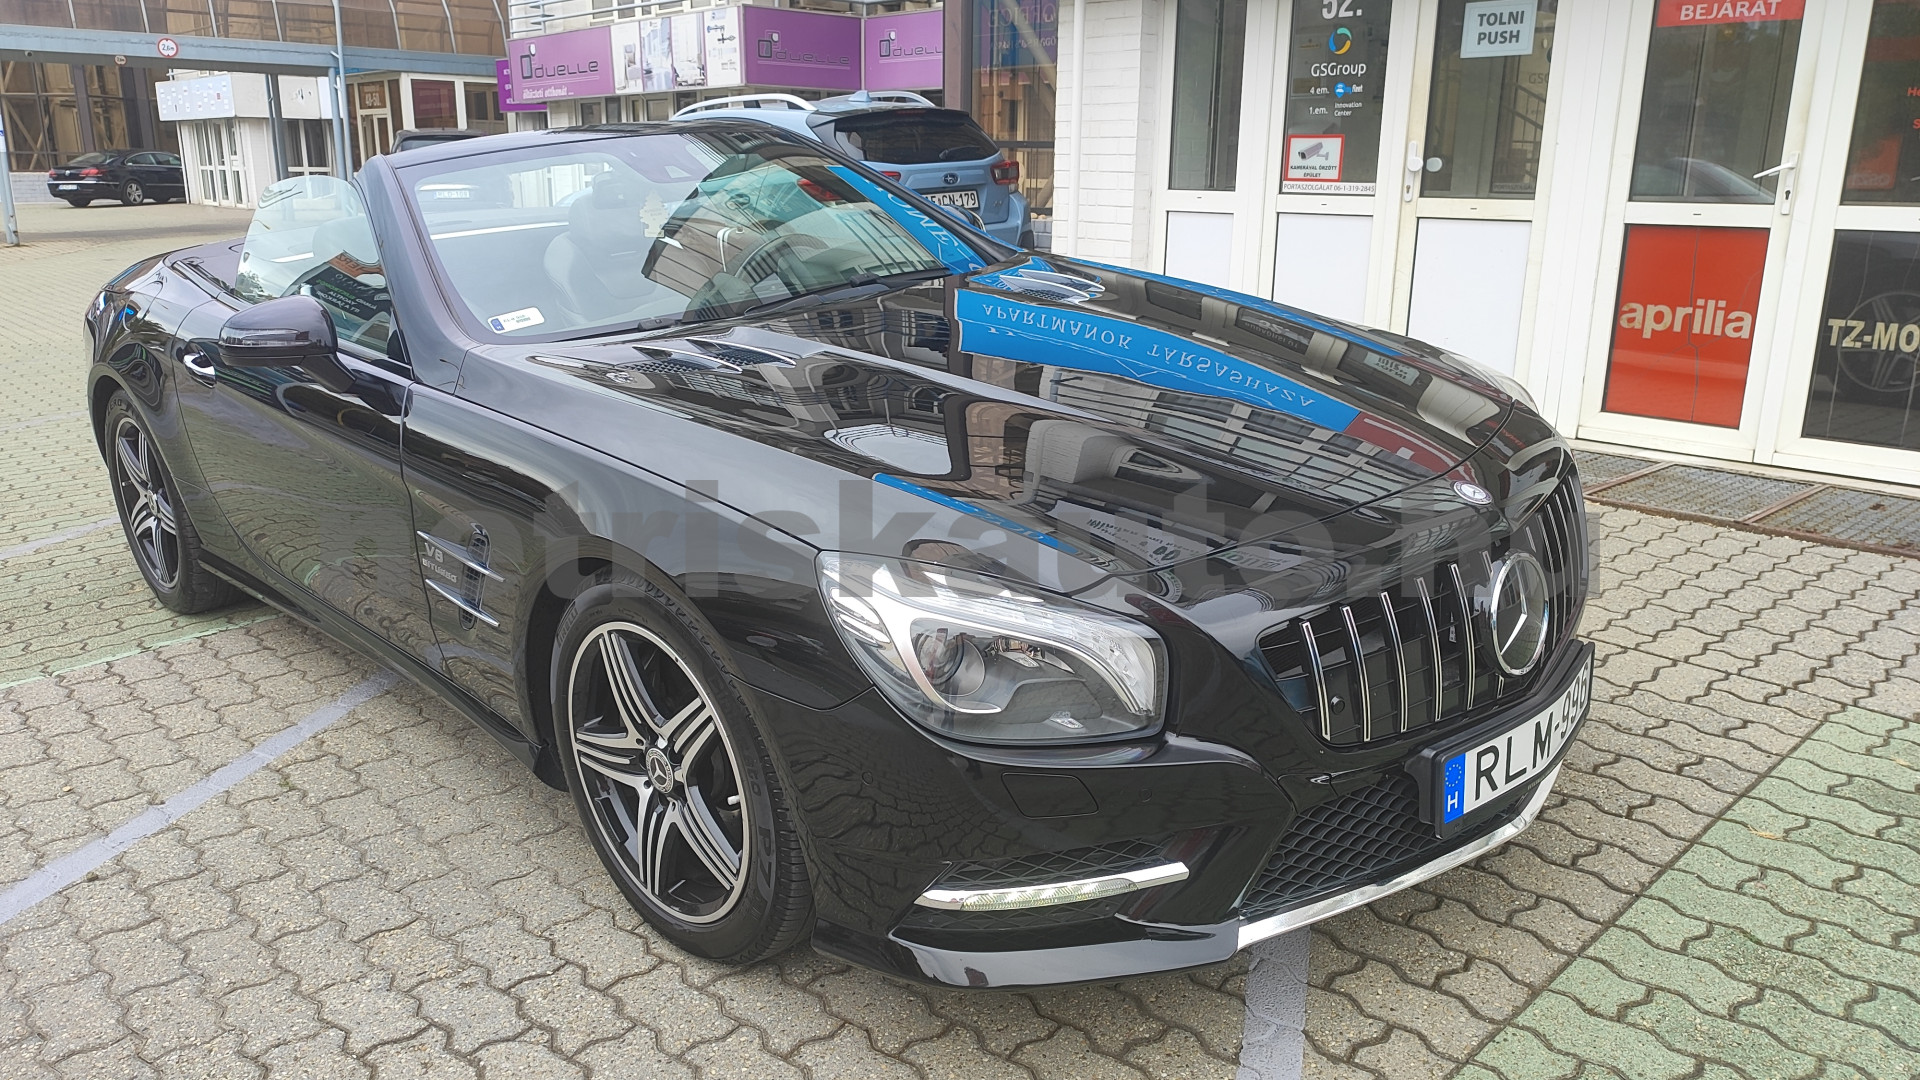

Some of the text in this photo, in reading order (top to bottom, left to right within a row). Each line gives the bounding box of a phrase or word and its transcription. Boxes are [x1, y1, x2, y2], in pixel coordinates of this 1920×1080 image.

[1477, 10, 1525, 27] TOLNI
[1680, 0, 1781, 21] BEJÁRAT
[1477, 29, 1520, 46] PUSH
[892, 45, 943, 57] duell
[1310, 62, 1367, 78] GSGroup
[1619, 298, 1753, 340] aprilia
[424, 542, 443, 563] V8
[1474, 661, 1590, 801] RLM-996
[1447, 790, 1459, 813] H
